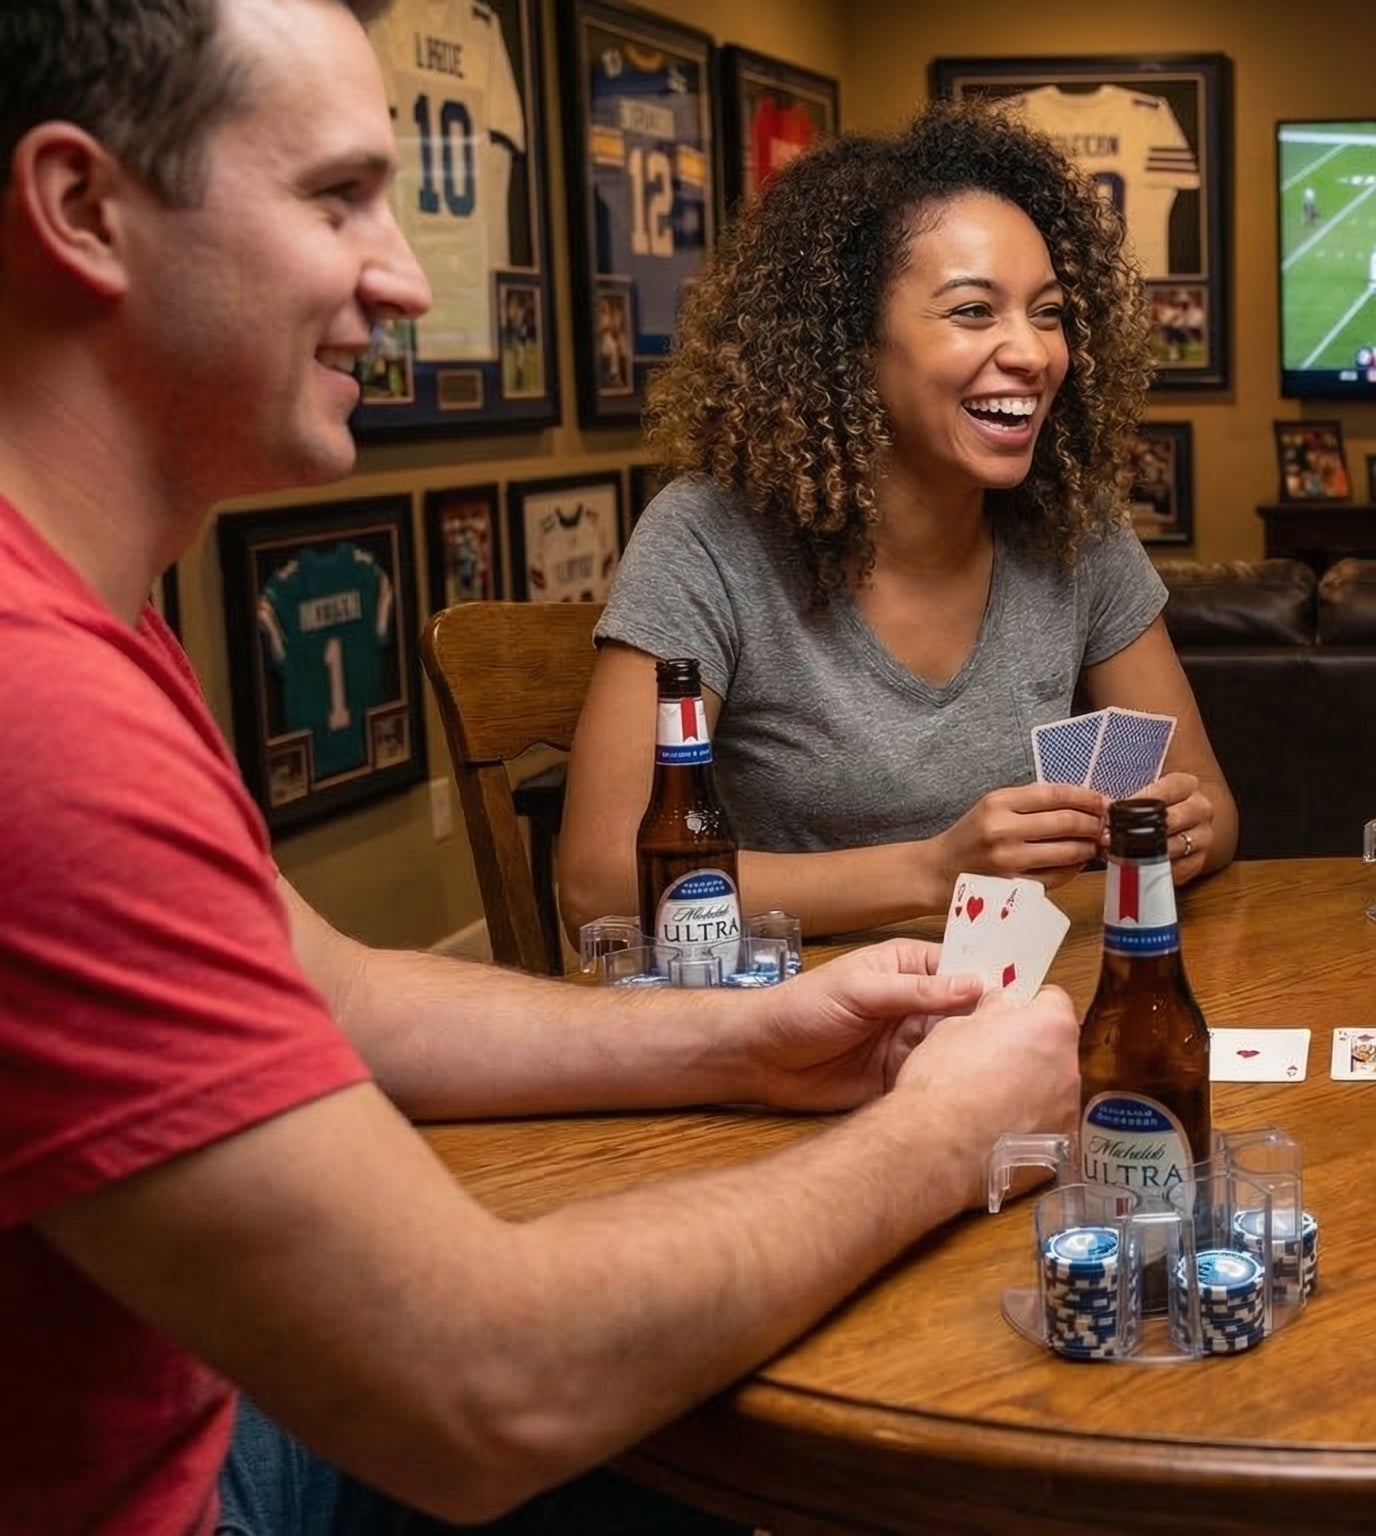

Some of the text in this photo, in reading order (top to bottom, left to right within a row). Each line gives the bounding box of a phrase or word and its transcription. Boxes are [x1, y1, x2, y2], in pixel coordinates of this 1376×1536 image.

[414, 94, 475, 217] 10
[629, 148, 673, 258] 12
[323, 637, 351, 731] 1
[664, 917, 739, 942] ULTRA
[1084, 1153, 1183, 1187] ULTRA
